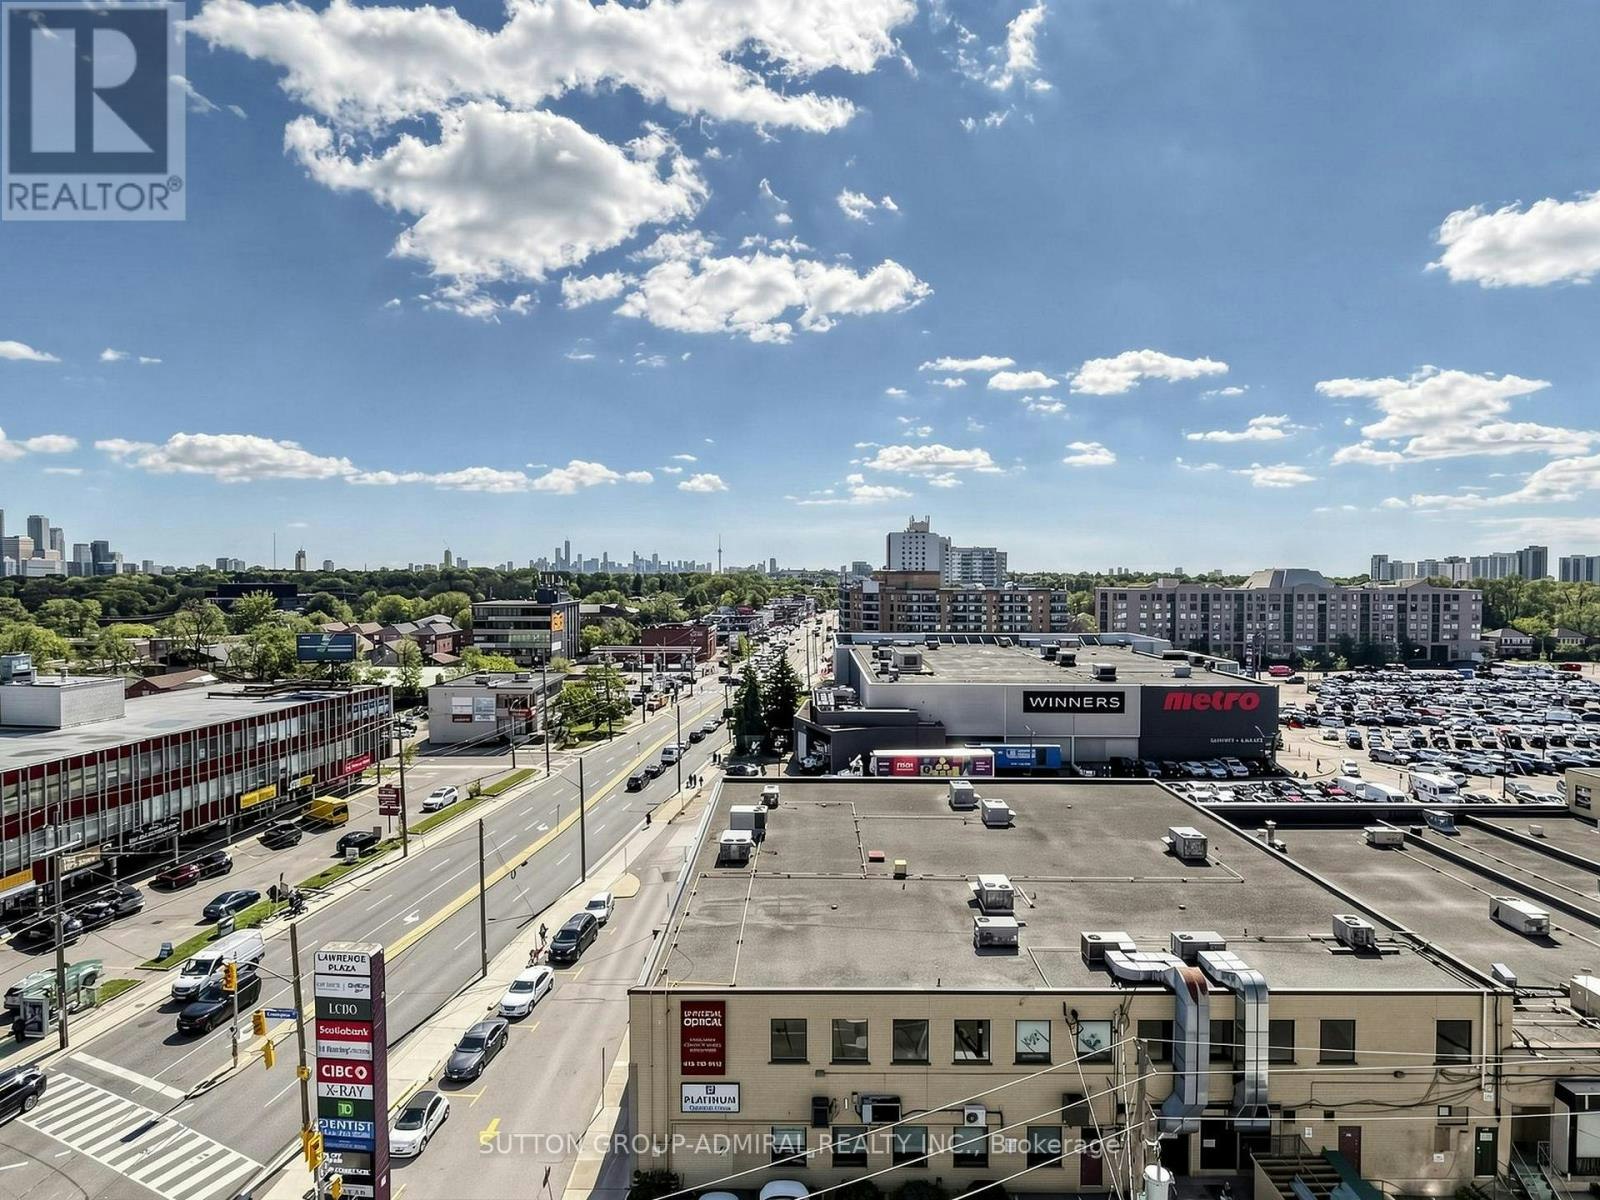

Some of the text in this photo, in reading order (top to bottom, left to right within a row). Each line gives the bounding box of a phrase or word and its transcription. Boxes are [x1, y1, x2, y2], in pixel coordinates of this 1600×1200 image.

[1029, 697, 1120, 708] WINNERS
[1163, 690, 1260, 711] metro
[328, 964, 356, 972] PLAZA
[319, 1025, 369, 1036] Scotiabank
[321, 1064, 354, 1078] CIBC
[326, 1084, 365, 1097] X-RAY
[684, 1095, 736, 1105] PLATINUM
